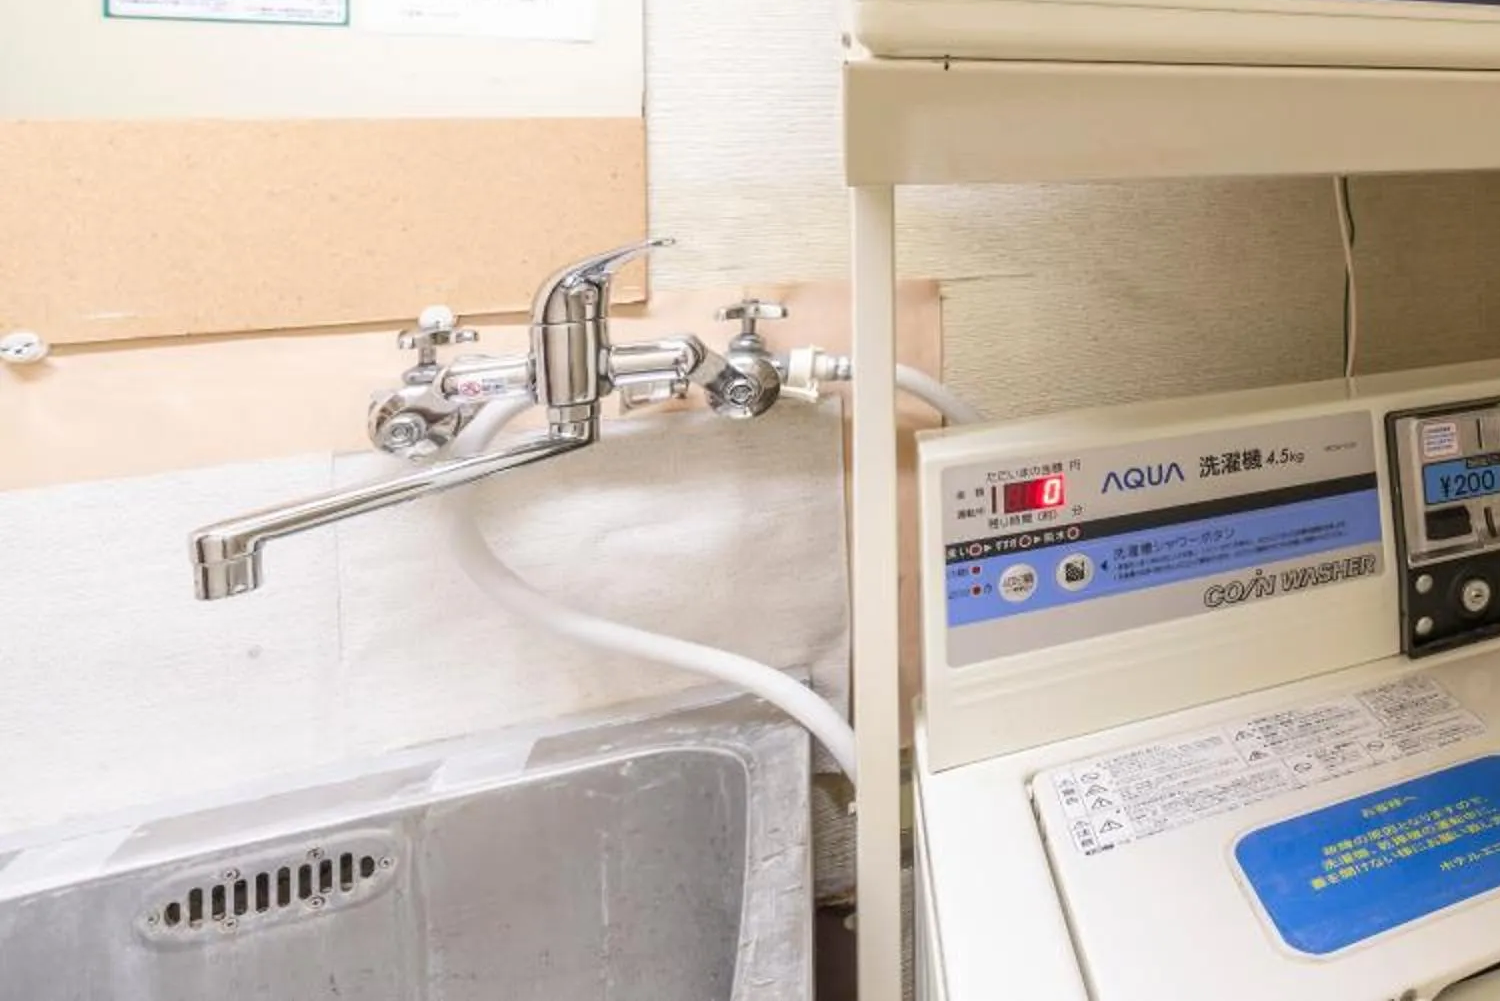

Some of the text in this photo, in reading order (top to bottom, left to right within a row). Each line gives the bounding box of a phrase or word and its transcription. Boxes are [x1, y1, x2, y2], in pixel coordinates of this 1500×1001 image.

[1069, 459, 1081, 472] 円
[1102, 448, 1305, 495] AQUA 洗濯機 4.5kg
[1043, 478, 1061, 505] 0
[1440, 469, 1495, 497] ¥200
[1281, 553, 1376, 591] WASHER
